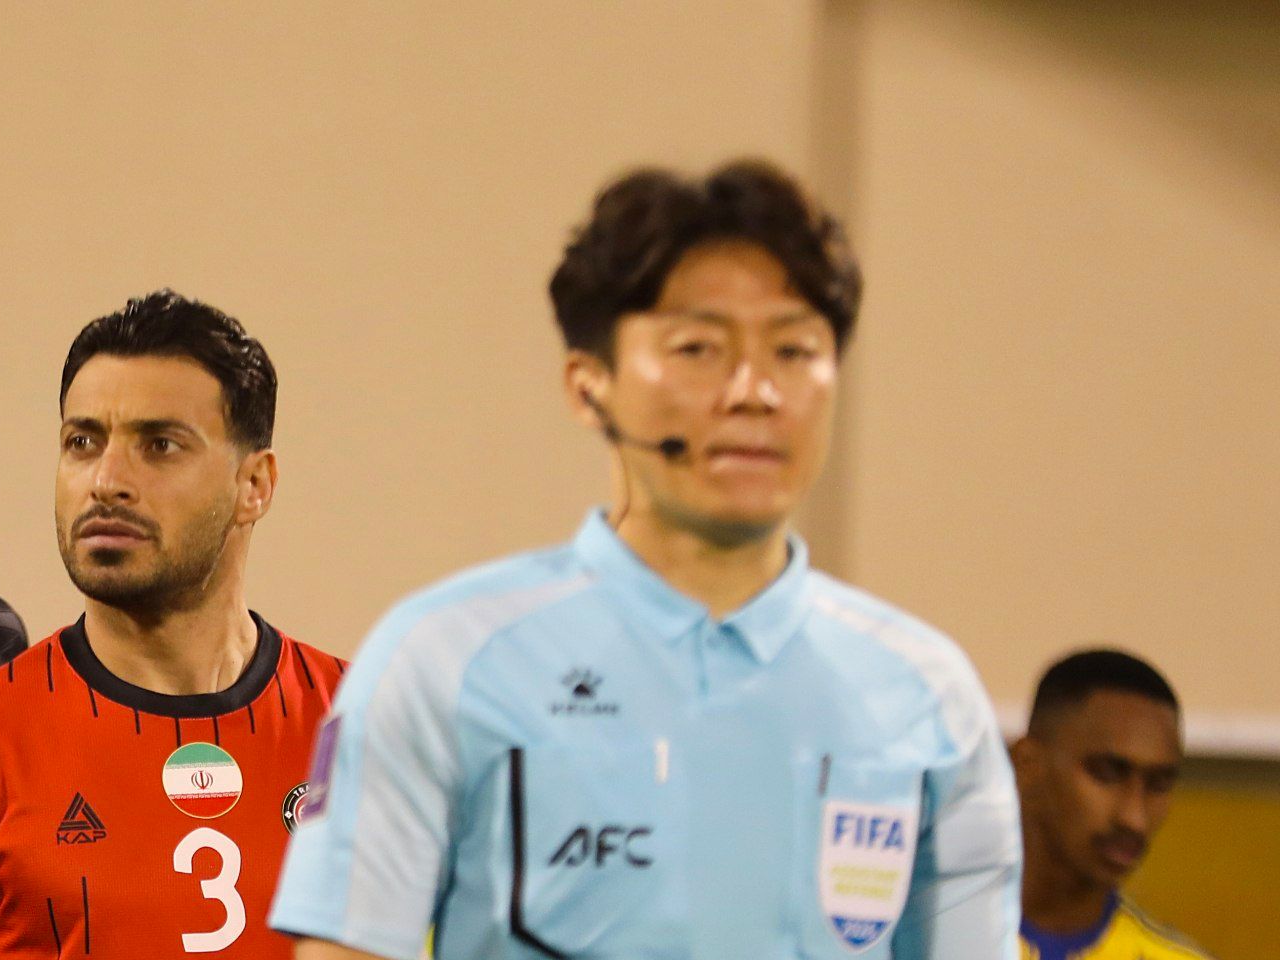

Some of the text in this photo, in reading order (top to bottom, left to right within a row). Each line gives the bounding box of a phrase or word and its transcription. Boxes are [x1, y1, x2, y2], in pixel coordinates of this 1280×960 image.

[56, 830, 107, 845] KAP
[547, 824, 654, 870] AFC
[833, 811, 904, 852] FIFA
[173, 826, 247, 953] 3
